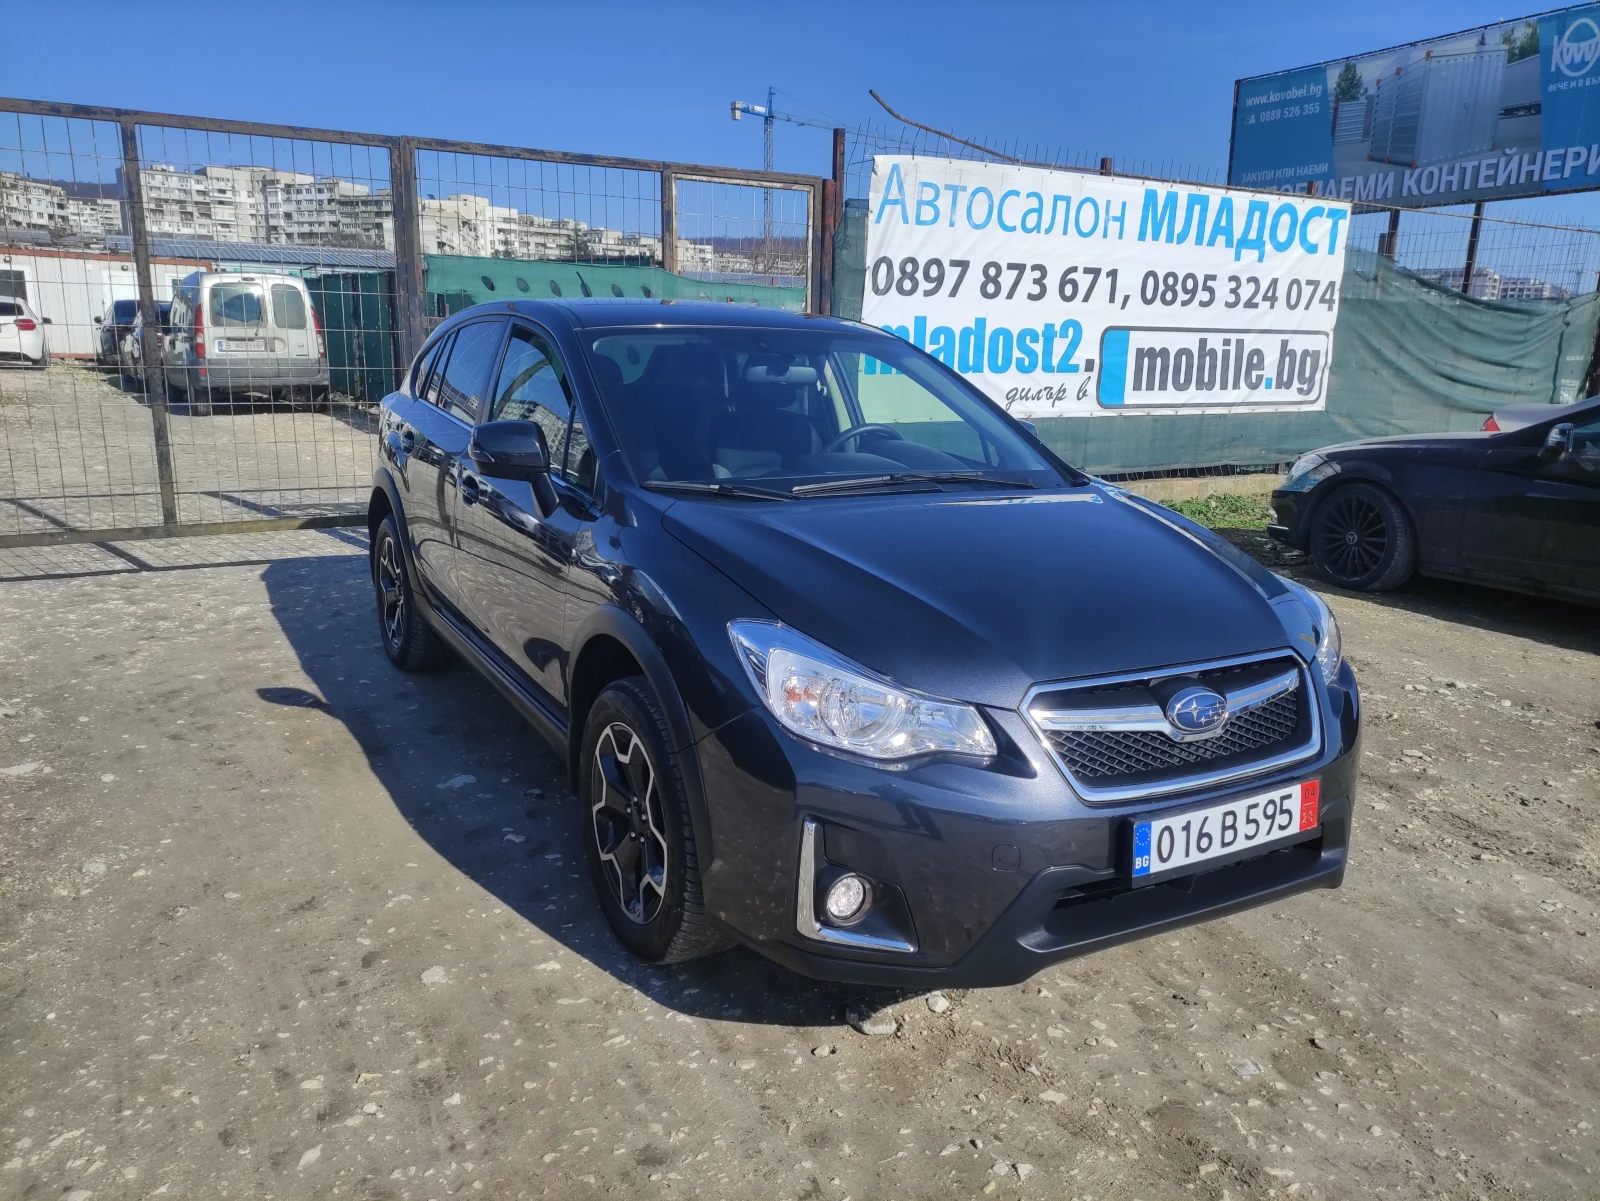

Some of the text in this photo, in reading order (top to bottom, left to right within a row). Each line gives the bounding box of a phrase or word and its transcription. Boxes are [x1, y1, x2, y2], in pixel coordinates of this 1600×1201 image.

[1246, 83, 1322, 107] www.kovobel.bg
[1548, 77, 1600, 92] ВЕЧЕ И В БЪ
[1260, 102, 1320, 123] 0888 526 355
[1241, 163, 1329, 183] ЗАКУПИ ИЛИ НАЕМИ
[875, 163, 1350, 263] Автосалон МЛАДОСТ
[871, 256, 1337, 312] 0897 873 671, 0895 324 074
[1132, 337, 1322, 395] mobile.bg
[1005, 383, 1068, 411] дилър
[1135, 855, 1150, 869] BG
